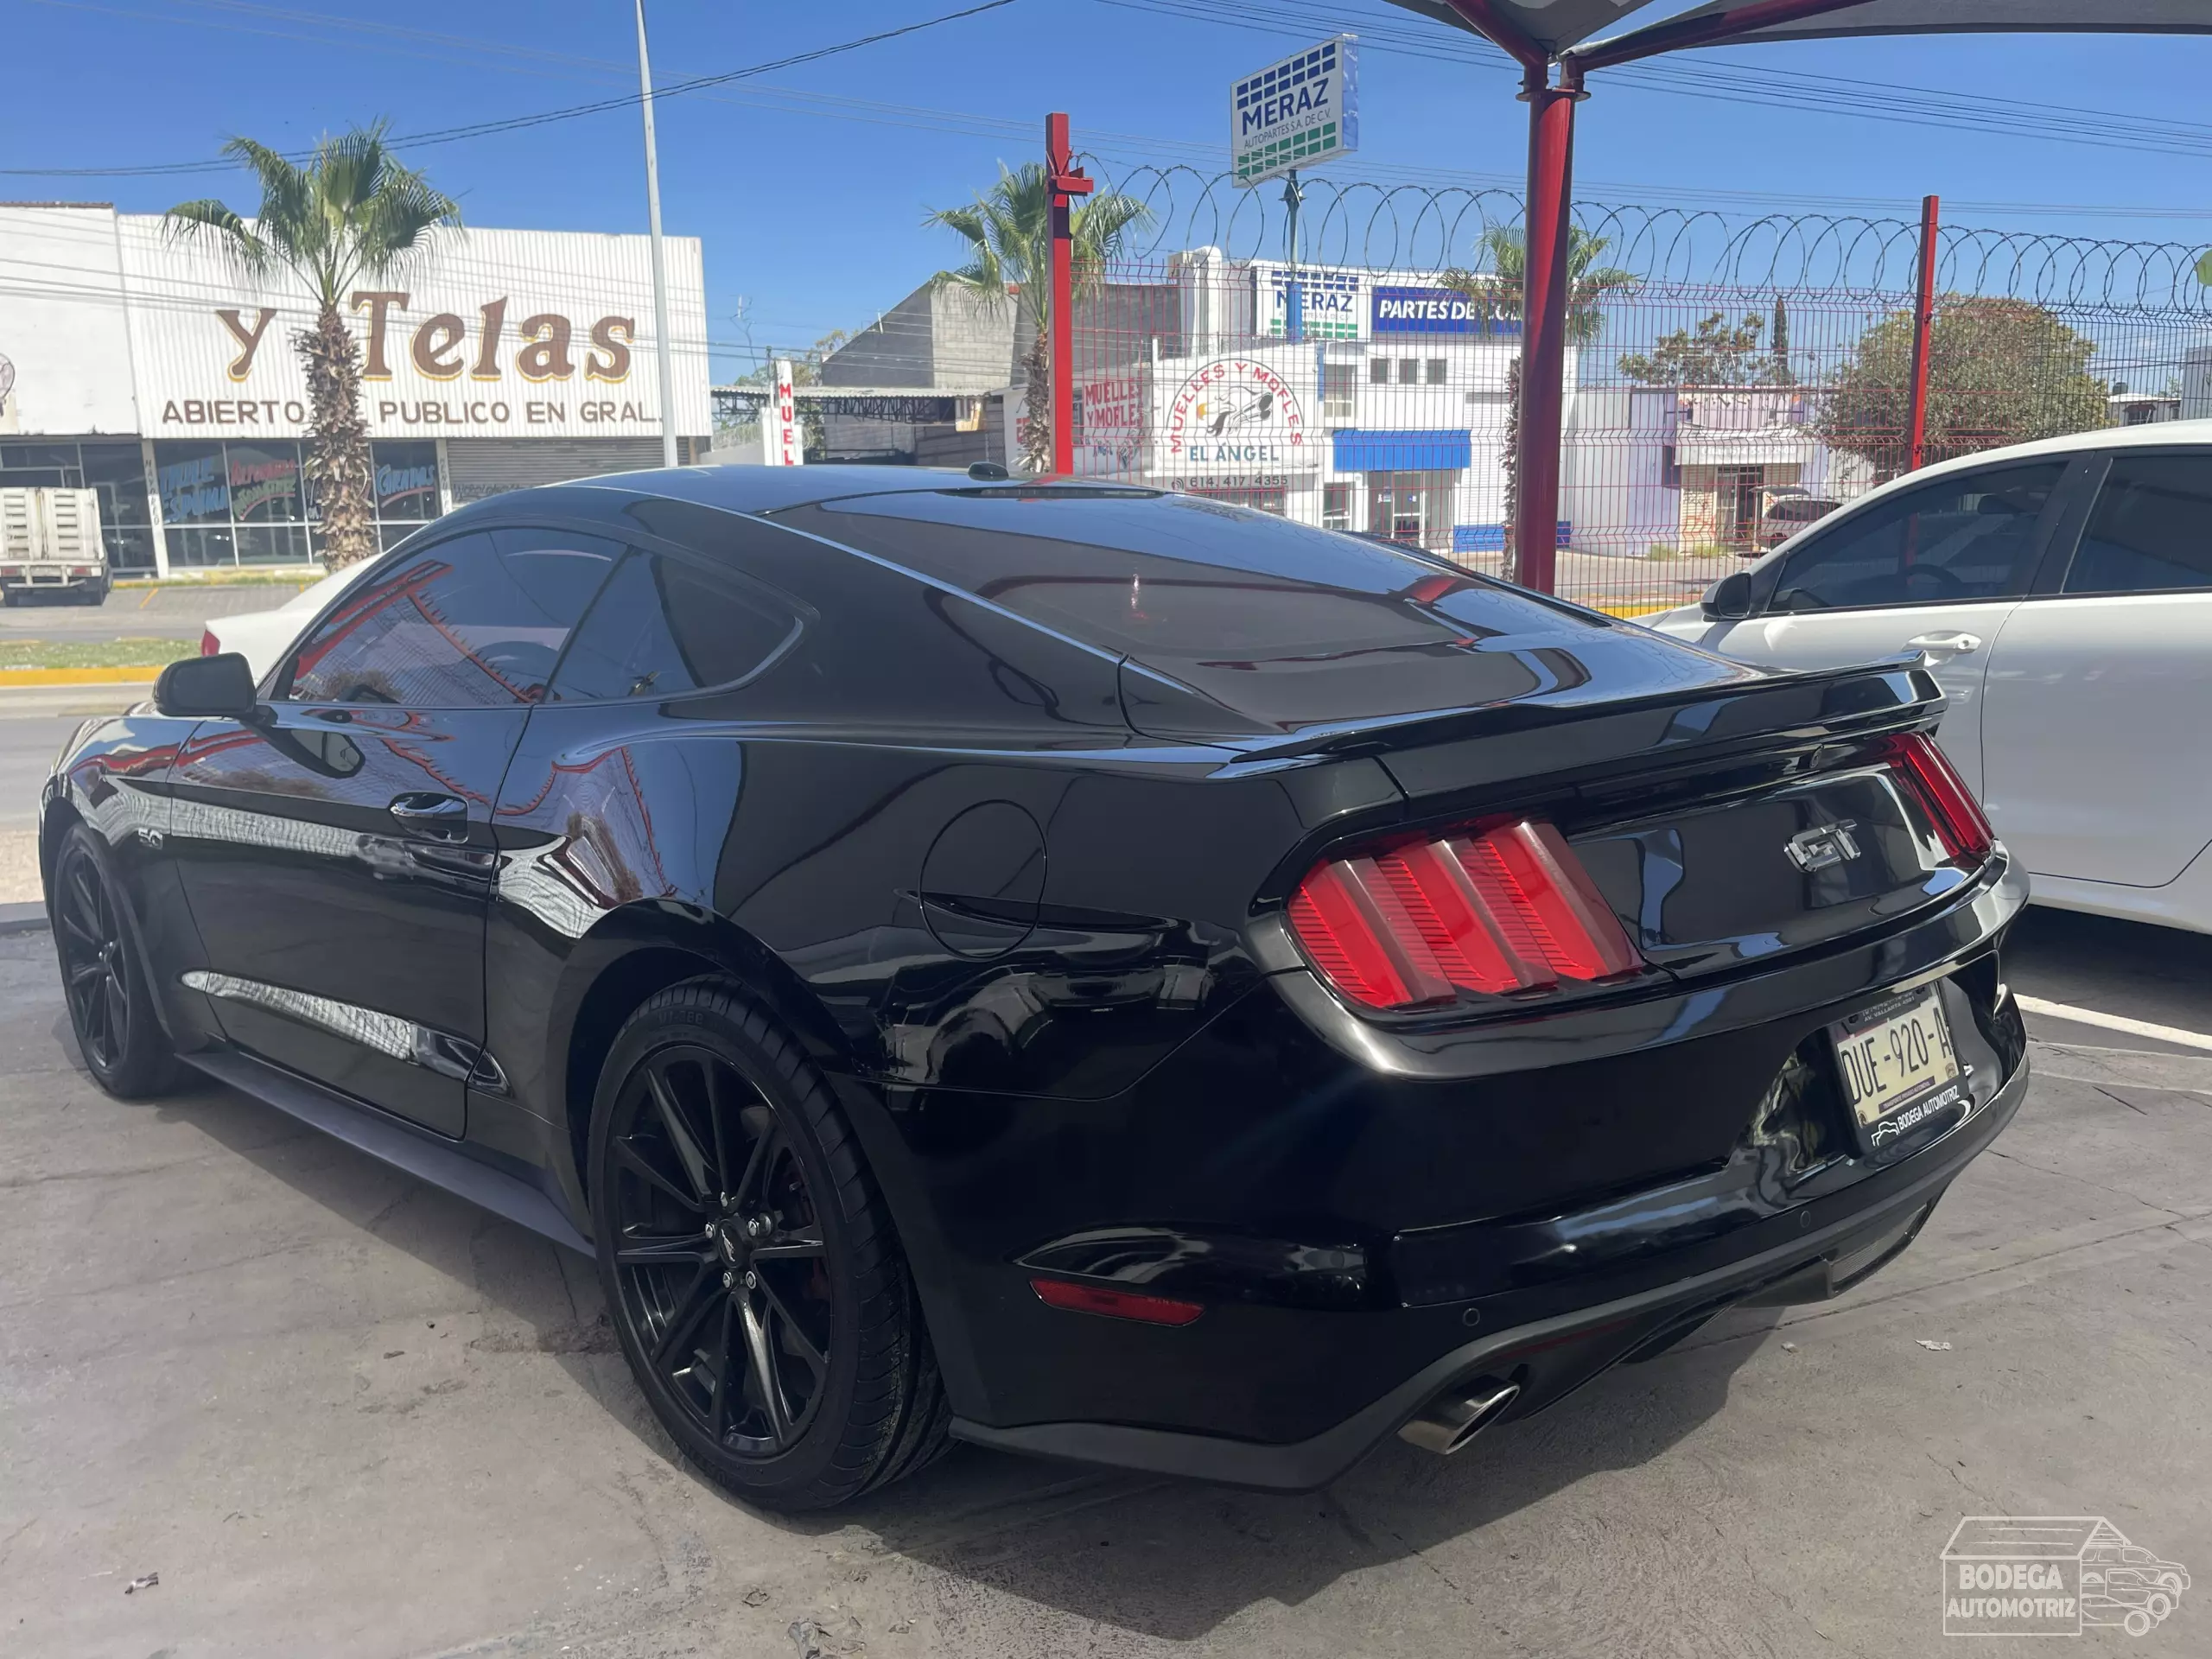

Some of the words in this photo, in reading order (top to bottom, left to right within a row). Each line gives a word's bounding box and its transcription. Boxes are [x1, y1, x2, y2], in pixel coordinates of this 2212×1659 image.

[1242, 77, 1329, 136] MERAZ
[1244, 124, 1290, 149] AUTOPARTES
[1305, 114, 1316, 126] DE
[1379, 300, 1450, 320] PARTES
[1452, 301, 1476, 321] DE
[350, 289, 635, 385] Telas
[162, 400, 304, 424] ABIERTO
[379, 401, 510, 424] PUBLICO
[526, 401, 566, 423] EN
[580, 401, 663, 423] GRAL.
[1171, 364, 1225, 454] MUELLES
[1235, 362, 1248, 373] Y
[1253, 367, 1302, 446] MOFLES
[1190, 446, 1209, 461] EL
[1216, 442, 1280, 462] ÁNGEL
[1255, 474, 1288, 486] 4355
[1897, 1105, 1923, 1131] BODEGA
[1923, 1084, 1960, 1116] AUTOMOTRIZ
